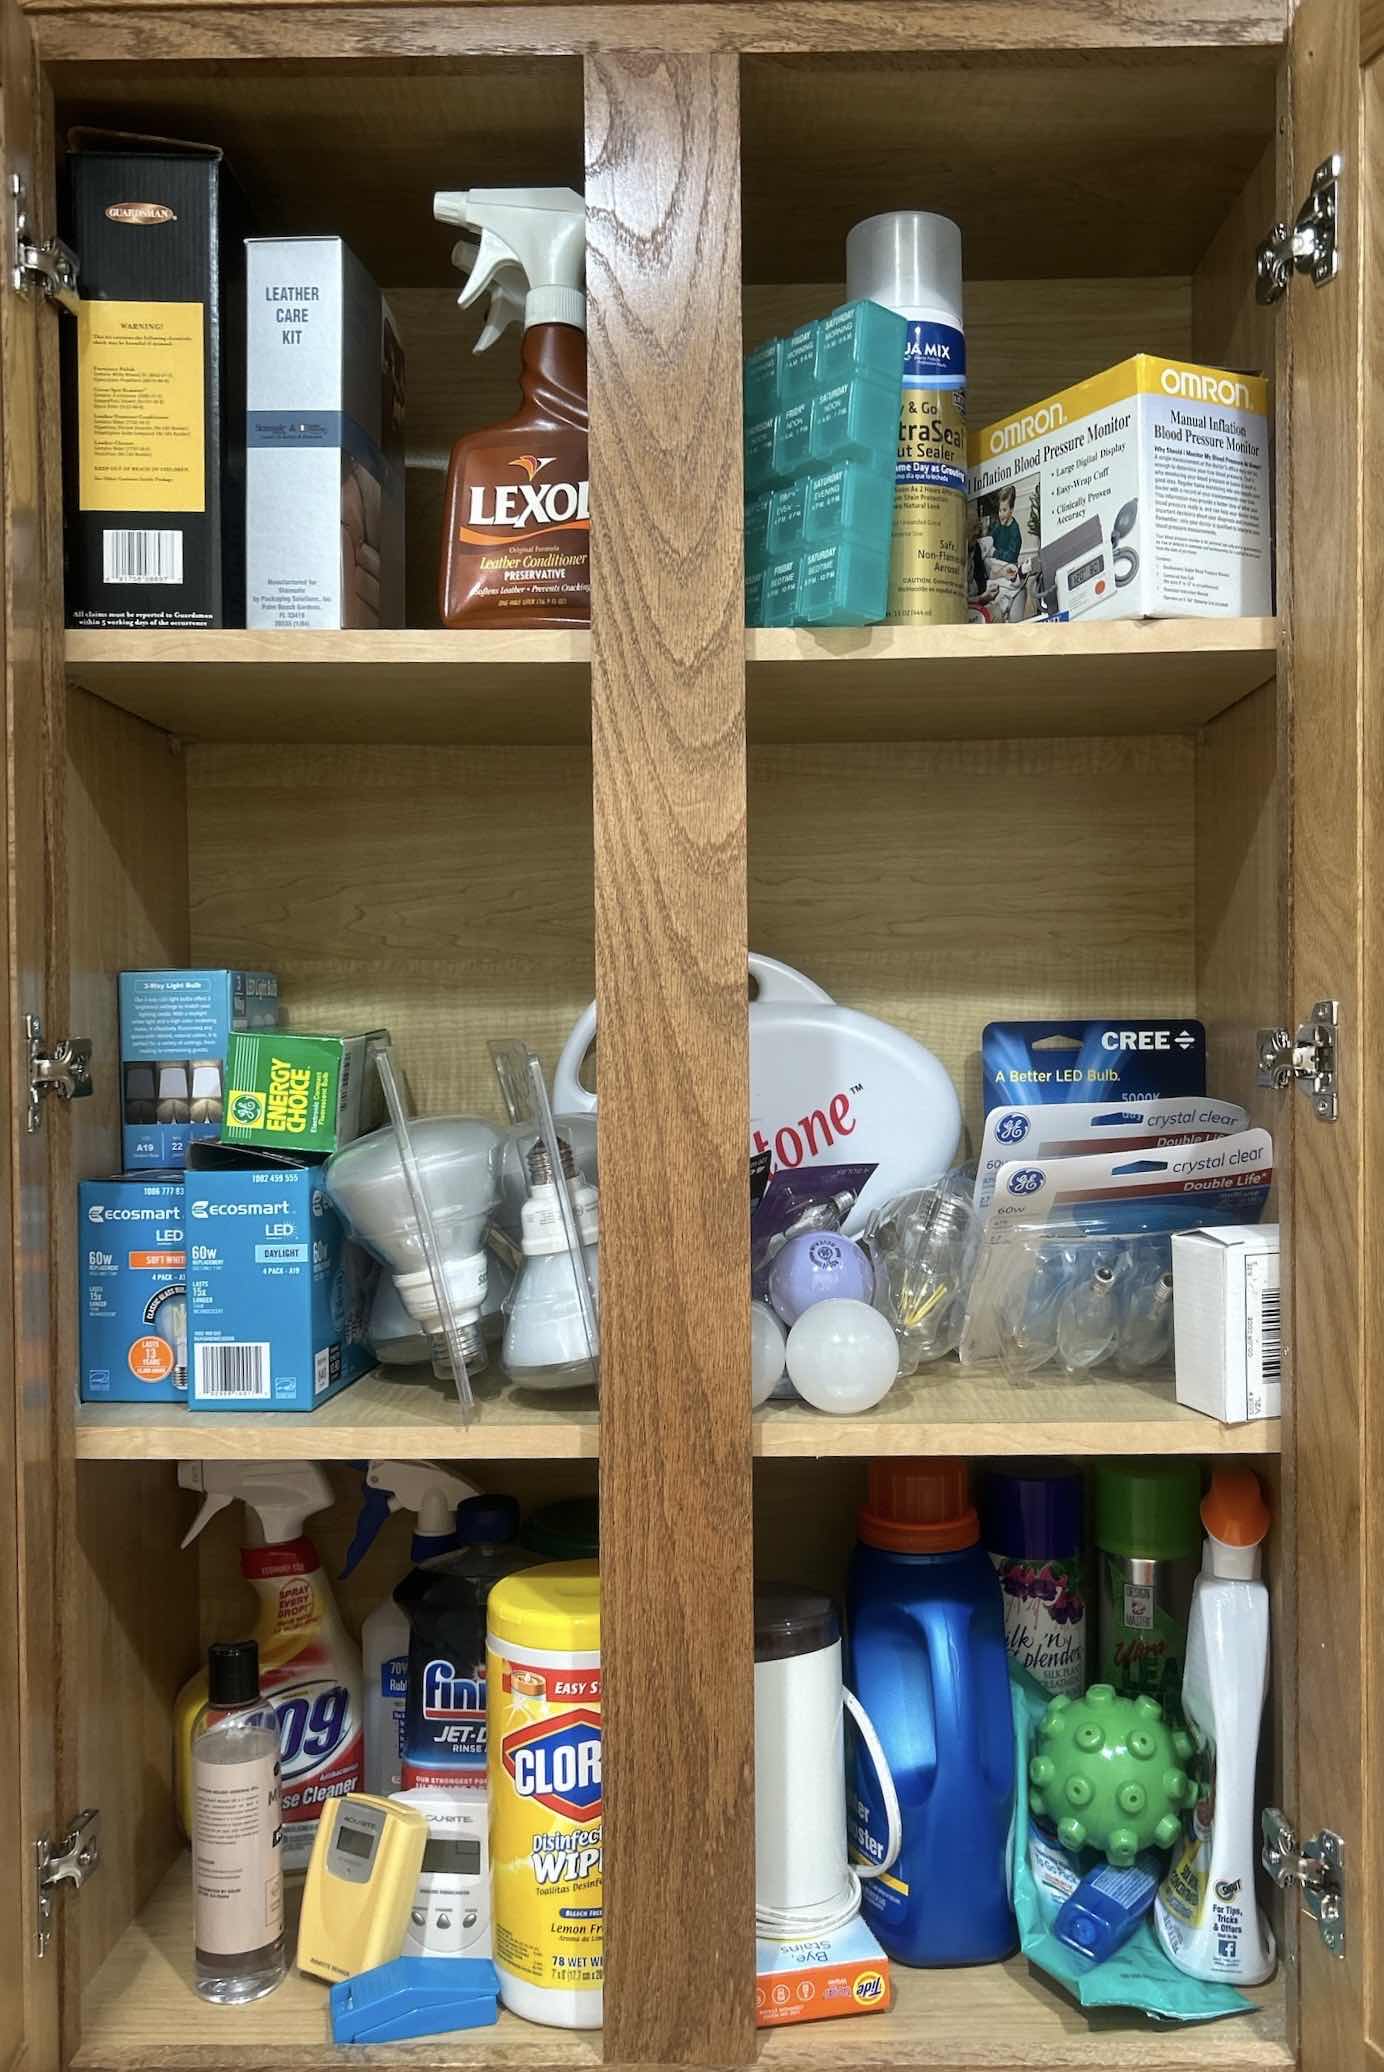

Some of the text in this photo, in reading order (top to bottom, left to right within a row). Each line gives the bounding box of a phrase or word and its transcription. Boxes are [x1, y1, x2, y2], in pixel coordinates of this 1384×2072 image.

[265, 287, 319, 301] LEATHER
[276, 308, 309, 323] CARE
[825, 310, 856, 330] SATURDAY
[282, 330, 302, 344] KIT
[792, 331, 811, 346] FRIDAY
[924, 343, 951, 360] MIX
[819, 384, 849, 405] SATURDAY
[1161, 368, 1250, 409] OMRON
[908, 401, 938, 415] & Go
[990, 403, 1065, 454] OMRON
[1170, 408, 1247, 438] Manual Inflation
[898, 419, 965, 450] traSeal
[1154, 424, 1260, 457] Blood Pressure Monitor
[917, 443, 955, 462] Sealer
[973, 413, 1132, 491] Inflation Blood Pressure Monitor
[1186, 449, 1204, 459] Monitor
[1212, 454, 1225, 462] Blood
[1056, 443, 1127, 477] Large Digital Display
[813, 471, 843, 490] SATURDAY
[917, 463, 929, 474] Day
[941, 464, 965, 483] Grouting
[1056, 467, 1110, 495] Easy-Wrap Cuff
[814, 485, 840, 500] EVENING
[1056, 488, 1112, 515] Clinically Proven
[1057, 510, 1087, 526] Accuracy
[509, 544, 560, 554] Original Formula
[807, 547, 837, 565] SATURDAY
[480, 553, 588, 570] Leather Conditioner
[774, 561, 794, 575] FRIDAY
[808, 561, 833, 576] BEDTIME
[504, 569, 566, 581] PRESERVATIVE
[500, 586, 525, 595] Leather
[532, 583, 560, 593] Prevents
[136, 612, 164, 620] reported
[166, 982, 184, 990] Light
[1101, 1031, 1170, 1050] CREE
[995, 1069, 1122, 1083] A Better LED Bulb.
[266, 1058, 291, 1132] ENERGY
[287, 1068, 310, 1134] CHOICE
[1121, 1092, 1161, 1104] 5000K
[1147, 1109, 1239, 1129] crystal clear
[752, 1093, 857, 1170] tone
[136, 1143, 154, 1152] A19
[172, 1142, 183, 1151] 22
[1157, 1136, 1202, 1148] Double
[1172, 1147, 1264, 1175] crystal clear
[253, 1174, 284, 1183] 1002 459
[1183, 1177, 1234, 1192] Double
[162, 1187, 174, 1196] 777
[156, 1229, 184, 1242] LED
[265, 1224, 294, 1236] LED
[89, 1251, 112, 1265] 60w
[146, 1255, 185, 1264] SOFT WHIT
[192, 1246, 217, 1260] 60w
[264, 1249, 299, 1258] DAYLIGHT
[268, 1267, 284, 1275] PACK
[289, 1266, 300, 1274] A19
[280, 1583, 311, 1599] SPRAY
[280, 1595, 310, 1608] EVERY
[1005, 1623, 1034, 1649] ilk
[423, 1660, 488, 1713] fini
[555, 1682, 587, 1695] EASY
[276, 1686, 349, 1763] 09
[434, 1725, 488, 1743] JET-D
[515, 1740, 602, 1796] CLOR
[431, 1776, 473, 1785] STRONGEST
[302, 1776, 358, 1805] Cleaner
[532, 1828, 602, 1852] Disinfec
[532, 1848, 602, 1885] WIP
[536, 1886, 571, 1897] Toallitas
[565, 1909, 588, 1917] BLEACH
[1212, 1904, 1243, 1917] For Tips,
[1217, 1914, 1239, 1924] Tricks
[551, 1923, 586, 1935] Lemon
[1213, 1923, 1242, 1934] & Offers
[780, 1940, 832, 1954] Stains
[552, 1956, 565, 1966] 78
[567, 1956, 587, 1968] WET
[792, 1951, 829, 1963] Bye,
[857, 1976, 882, 1998] Tide
